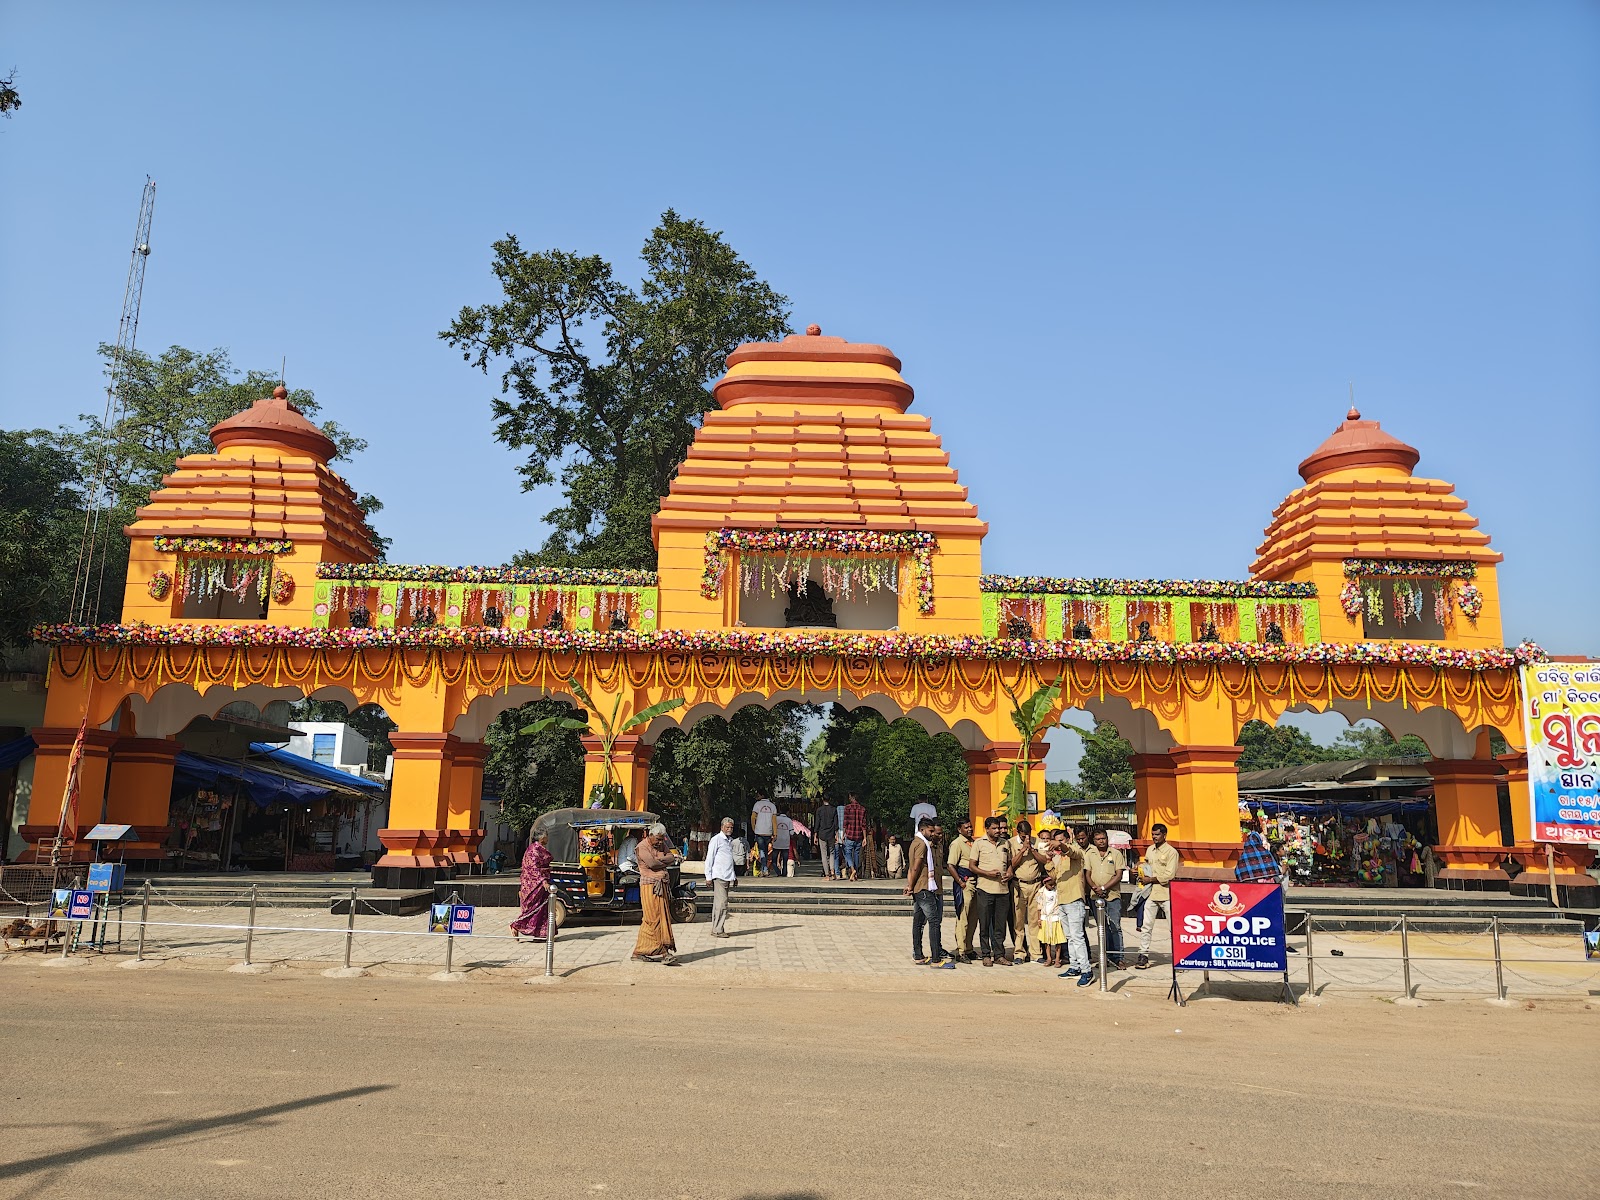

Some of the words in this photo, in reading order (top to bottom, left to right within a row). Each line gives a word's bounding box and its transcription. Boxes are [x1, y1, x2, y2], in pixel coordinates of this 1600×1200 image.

[1537, 668, 1570, 685] ପବିତ୍ର
[77, 895, 89, 904] NO
[457, 910, 469, 918] NO
[1183, 915, 1271, 935] STOP
[1180, 935, 1230, 944] RARUAN
[1233, 936, 1276, 946] POLICE
[1225, 947, 1244, 958] SBI
[1180, 959, 1208, 968] Courtesy
[1213, 960, 1226, 968] SBI,
[1227, 960, 1255, 969] Khiching
[1256, 961, 1279, 969] Branch
